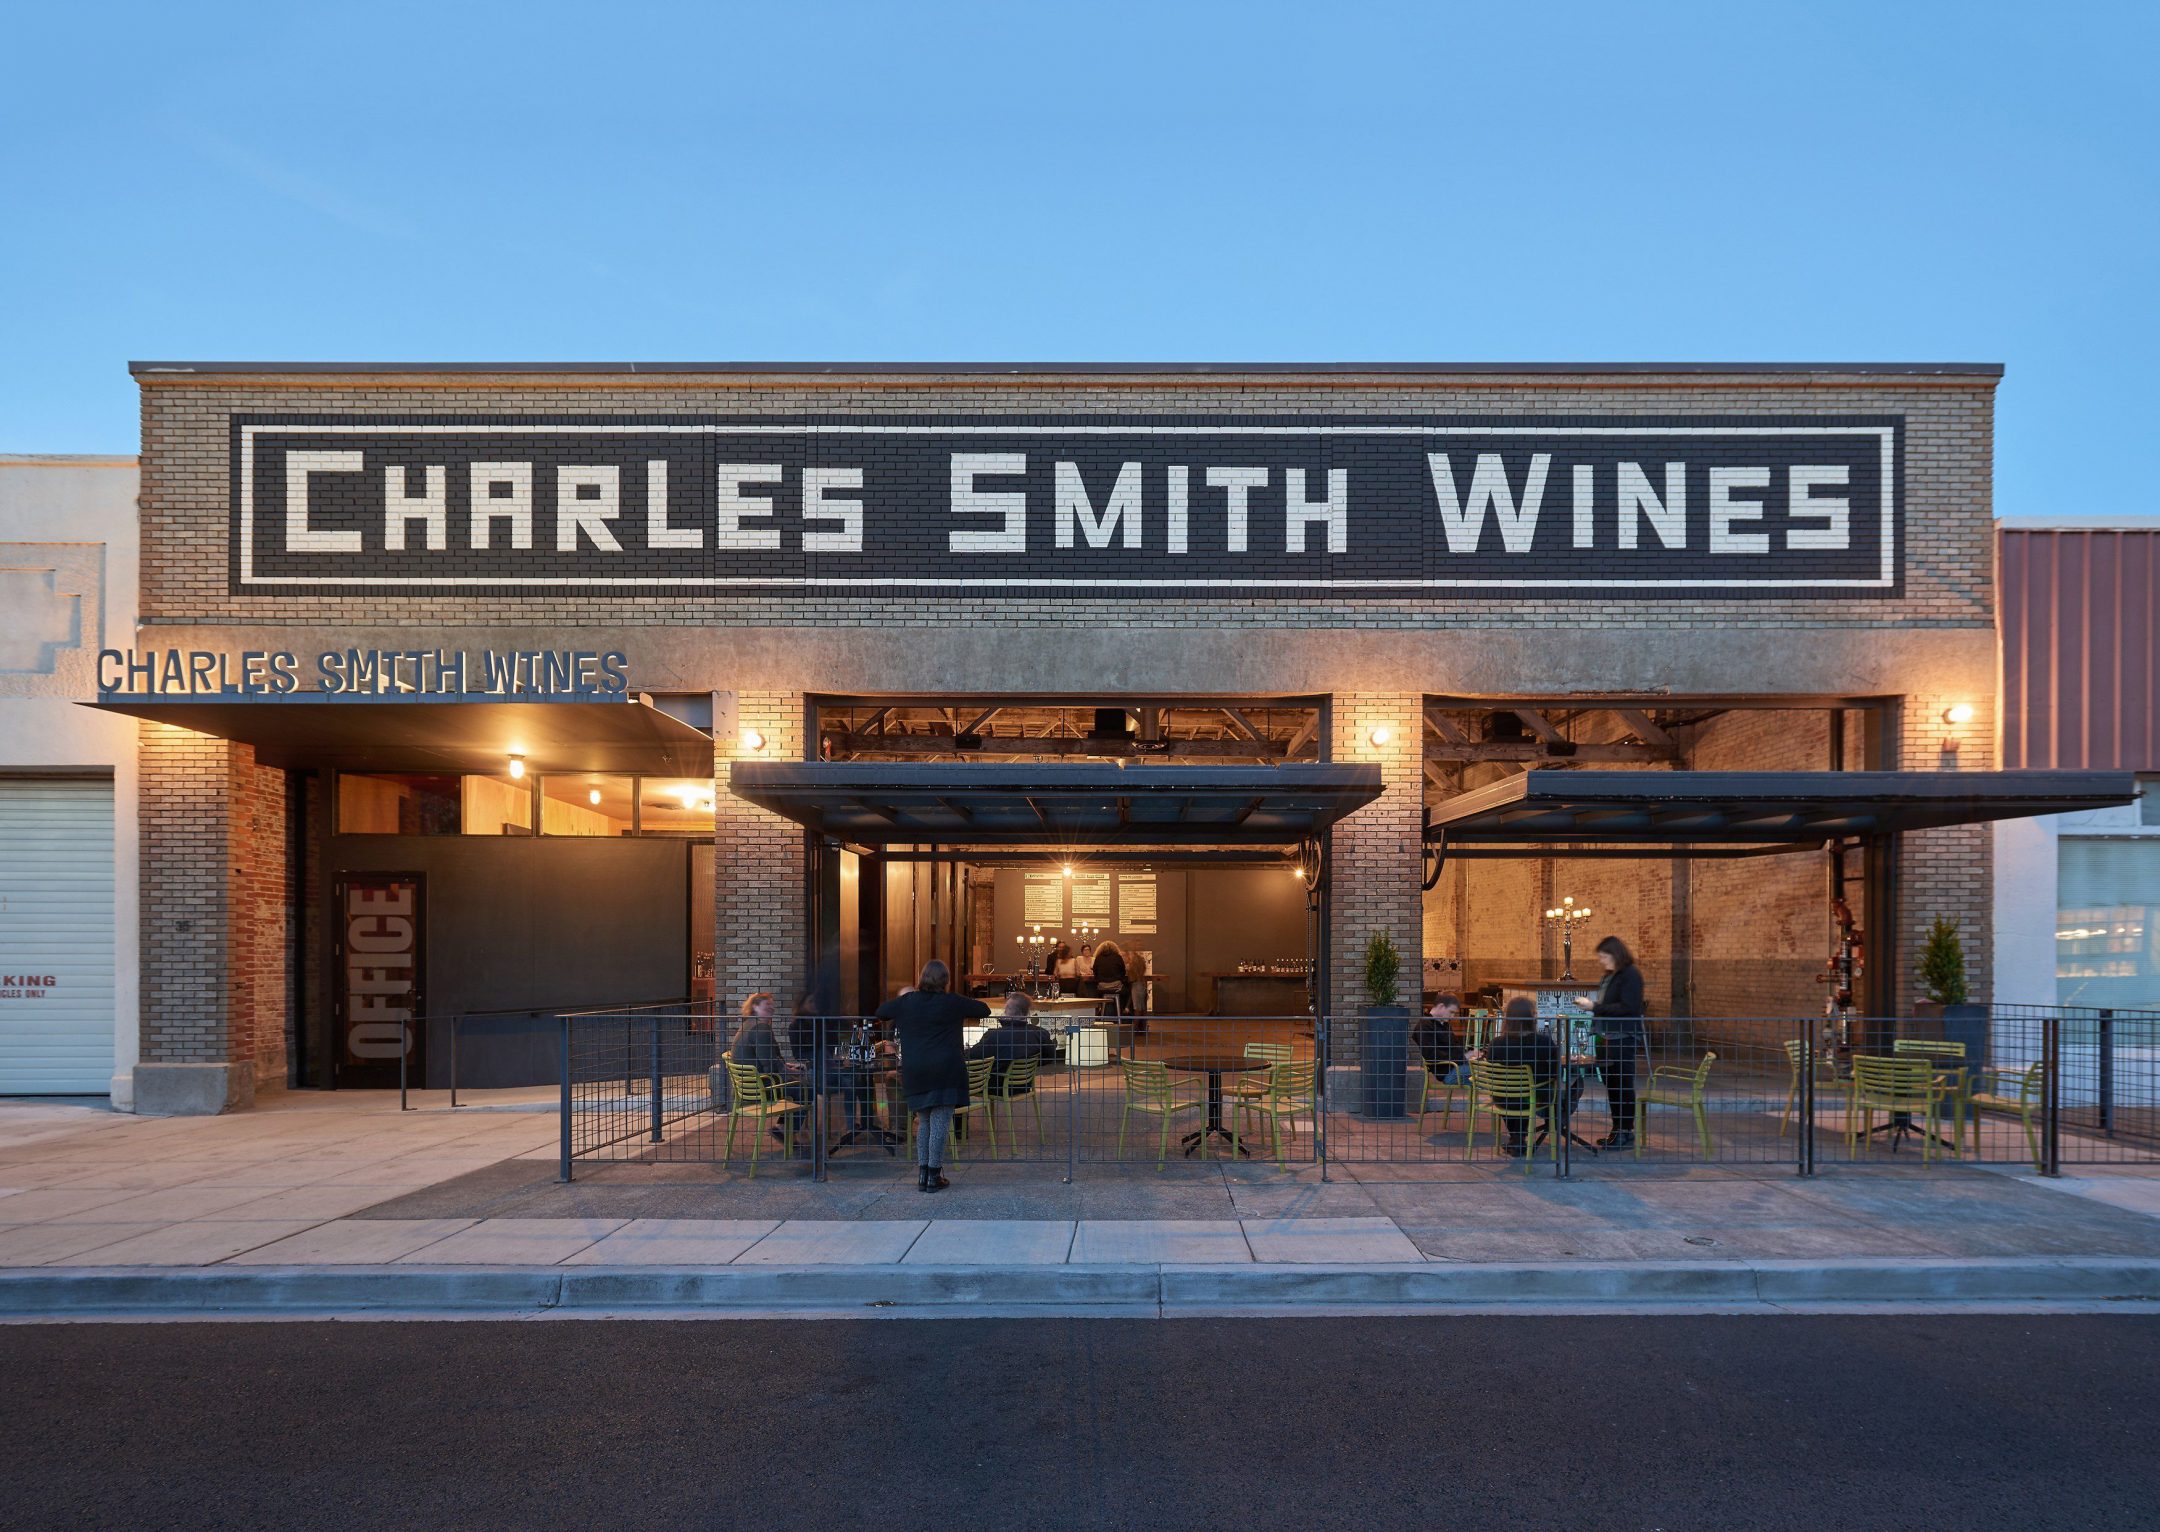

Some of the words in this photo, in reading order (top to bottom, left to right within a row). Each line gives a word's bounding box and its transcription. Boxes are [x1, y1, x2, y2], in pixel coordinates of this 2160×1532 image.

[286, 450, 864, 552] CHARLES
[949, 452, 1347, 554] SMITH
[1427, 453, 1850, 554] WINES
[97, 649, 299, 694] CHARLES
[317, 648, 467, 694] SMITH
[484, 649, 629, 694] WINES
[0, 976, 56, 986] KING
[25, 989, 46, 999] ONLY
[348, 889, 414, 1059] OFFICE
